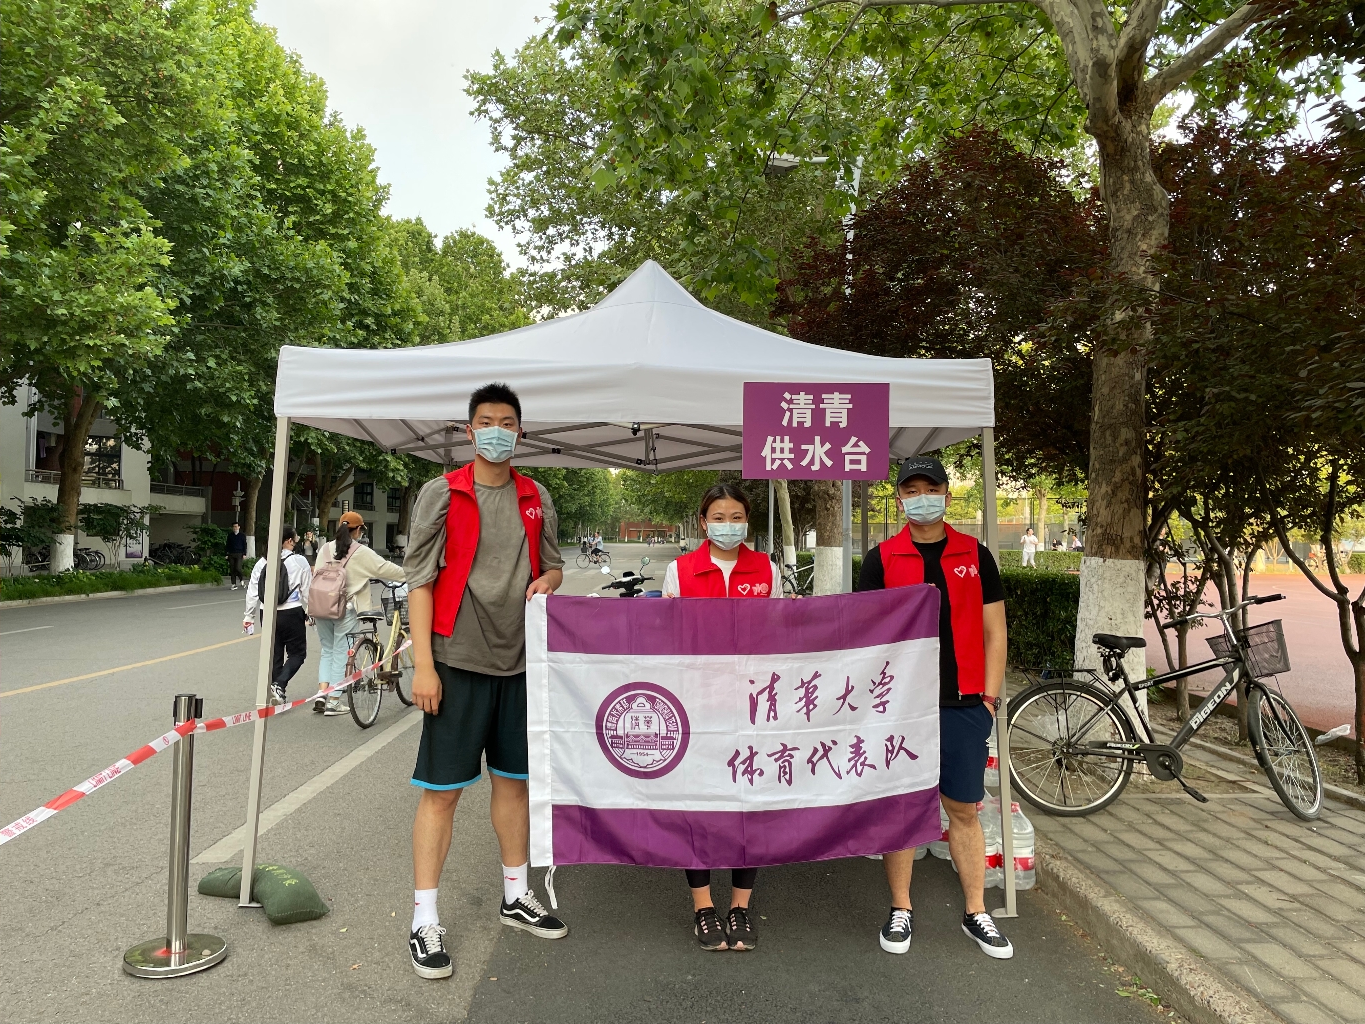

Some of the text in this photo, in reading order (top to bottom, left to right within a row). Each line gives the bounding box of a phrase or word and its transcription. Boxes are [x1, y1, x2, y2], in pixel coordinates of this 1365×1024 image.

[780, 391, 853, 428] 清青
[760, 435, 872, 472] 供水台
[1189, 681, 1233, 730] PIGEON
[726, 734, 920, 787] 体育代表队
